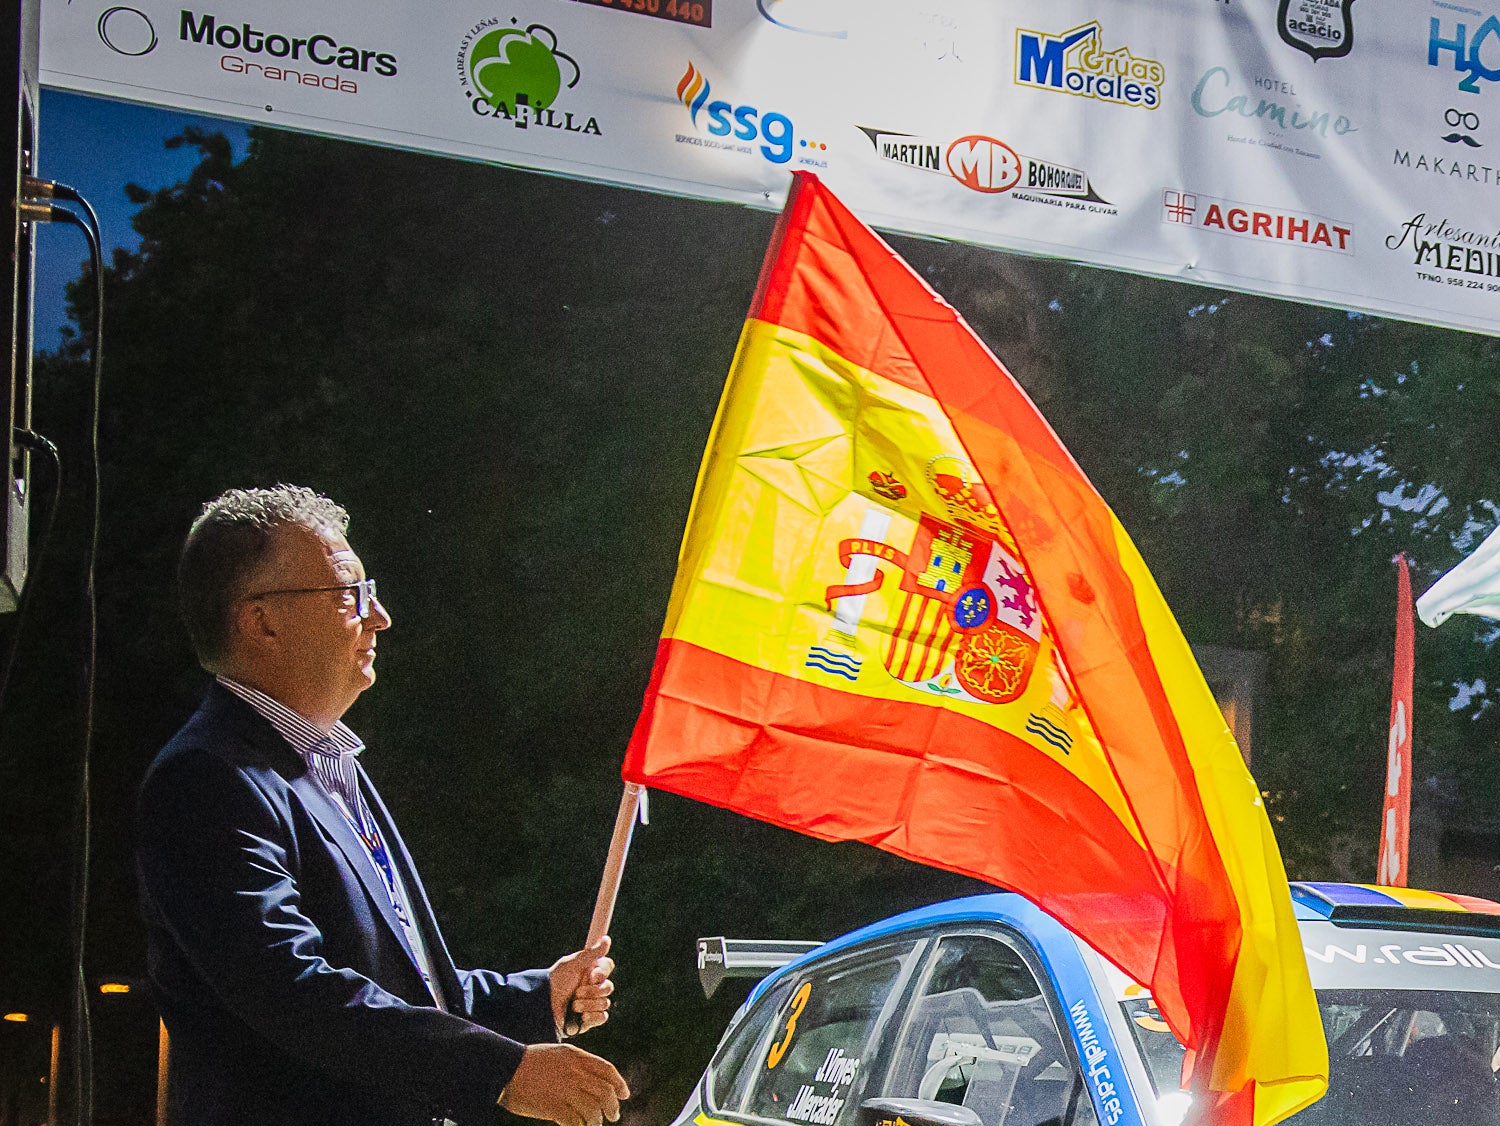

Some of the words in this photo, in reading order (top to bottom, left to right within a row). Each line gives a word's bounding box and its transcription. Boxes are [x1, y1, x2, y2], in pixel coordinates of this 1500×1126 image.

[666, 0, 704, 22] 440
[1288, 19, 1341, 40] acacio
[179, 9, 398, 77] MotorCars
[457, 39, 470, 86] MADERAS
[470, 17, 499, 36] LEÑAS
[1081, 42, 1163, 84] Grúas
[220, 56, 358, 94] Granada
[1019, 30, 1159, 105] Morales
[1254, 76, 1296, 96] HOTEL
[1190, 66, 1359, 138] Camino
[707, 100, 794, 164] ssg
[883, 143, 940, 170] MARTIN
[949, 139, 1019, 190] MB
[1028, 160, 1083, 190] BOHORQUEZ
[1011, 192, 1063, 208] MAQUINARIA
[1065, 201, 1087, 212] PARA
[1088, 205, 1118, 216] OLIVAR
[1203, 203, 1351, 251] AGRIHAT
[1466, 279, 1484, 291] 224
[850, 541, 896, 561] PLVS
[767, 982, 812, 1070] 3
[1070, 999, 1127, 1126] www.rallycar.es
